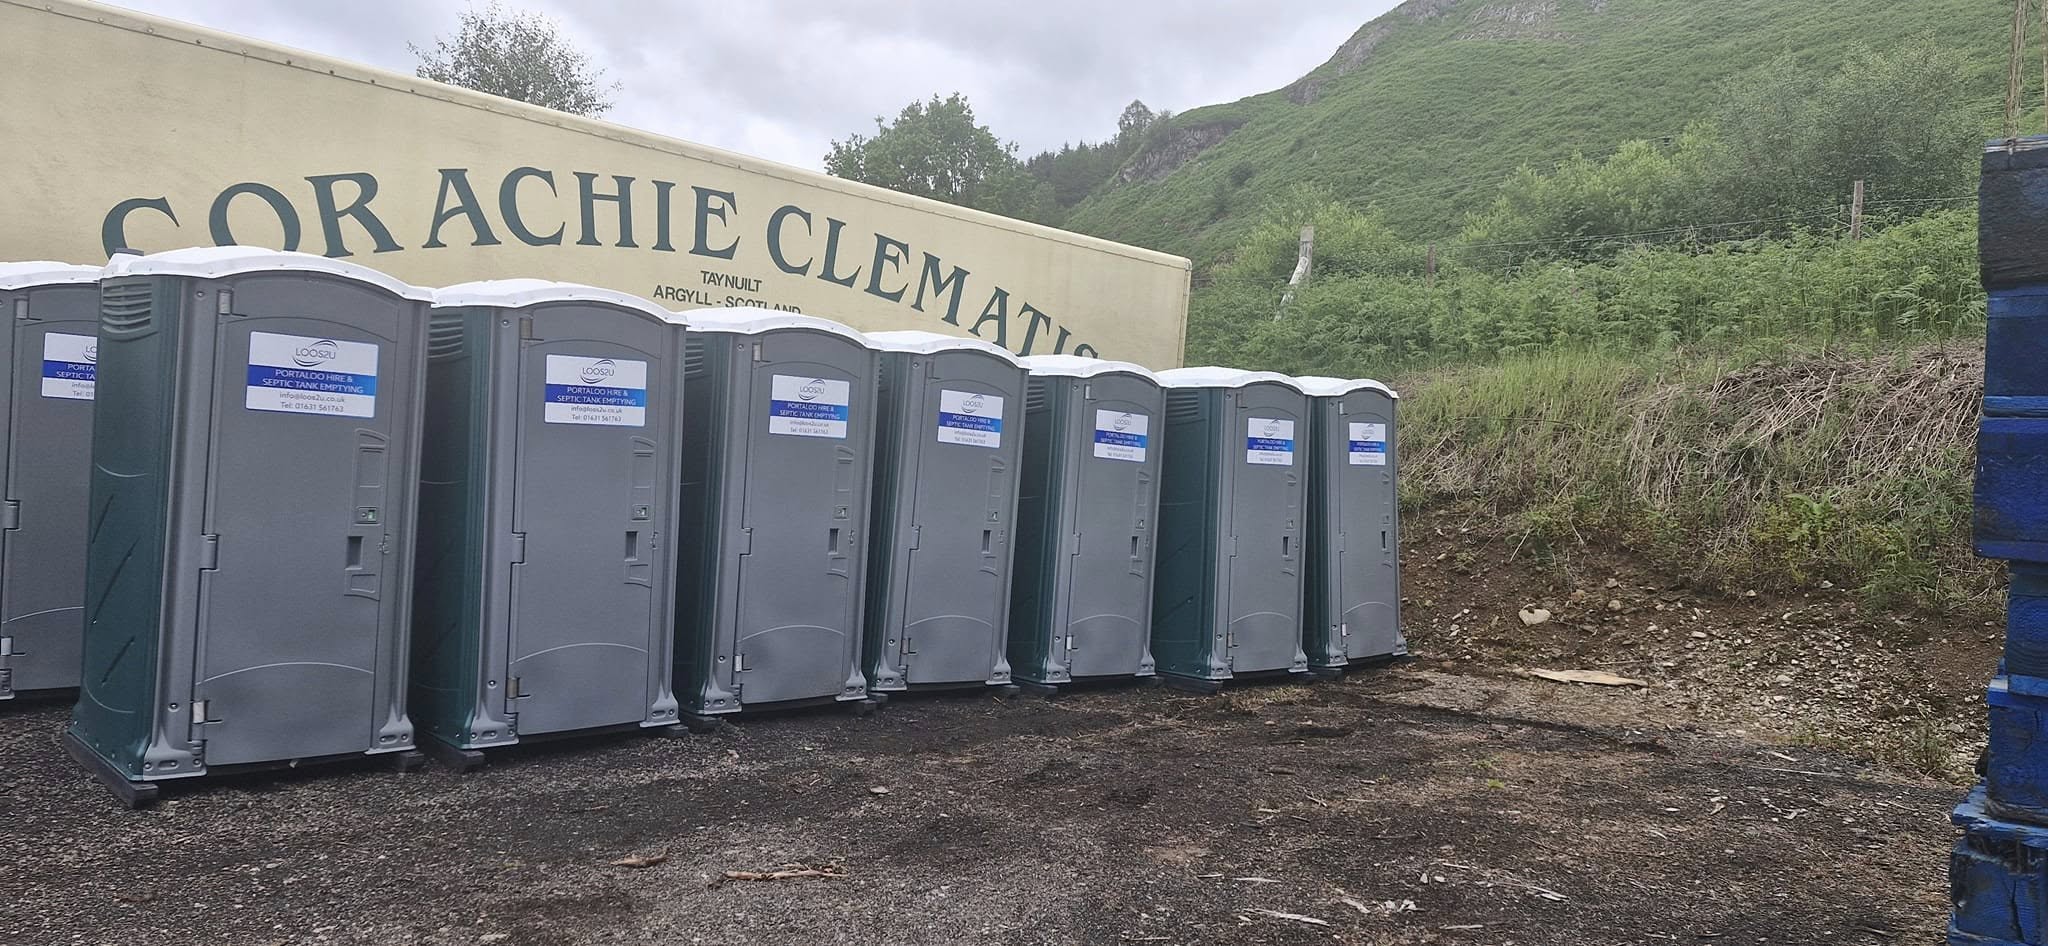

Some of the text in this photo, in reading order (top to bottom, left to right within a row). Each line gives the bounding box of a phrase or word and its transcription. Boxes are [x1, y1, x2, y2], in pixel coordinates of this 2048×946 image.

[700, 270, 762, 293] TAYNUILT
[653, 285, 713, 306] ARGYLL
[295, 348, 336, 360] LOOS2U
[67, 363, 95, 372] PORTA
[582, 367, 614, 376] LOOS2U
[56, 371, 85, 379] SEPTIC
[275, 369, 325, 381] PORTALOO
[326, 374, 346, 383] HIRE
[262, 378, 364, 393] SEPTIC TANK EMPTYING
[567, 386, 606, 396] PORTALOO
[279, 391, 345, 403] info@loos2u.co.uk
[557, 395, 581, 403] SEPTIC
[602, 398, 636, 406] EMPTYING
[281, 401, 344, 413] Tel: 01631 561763
